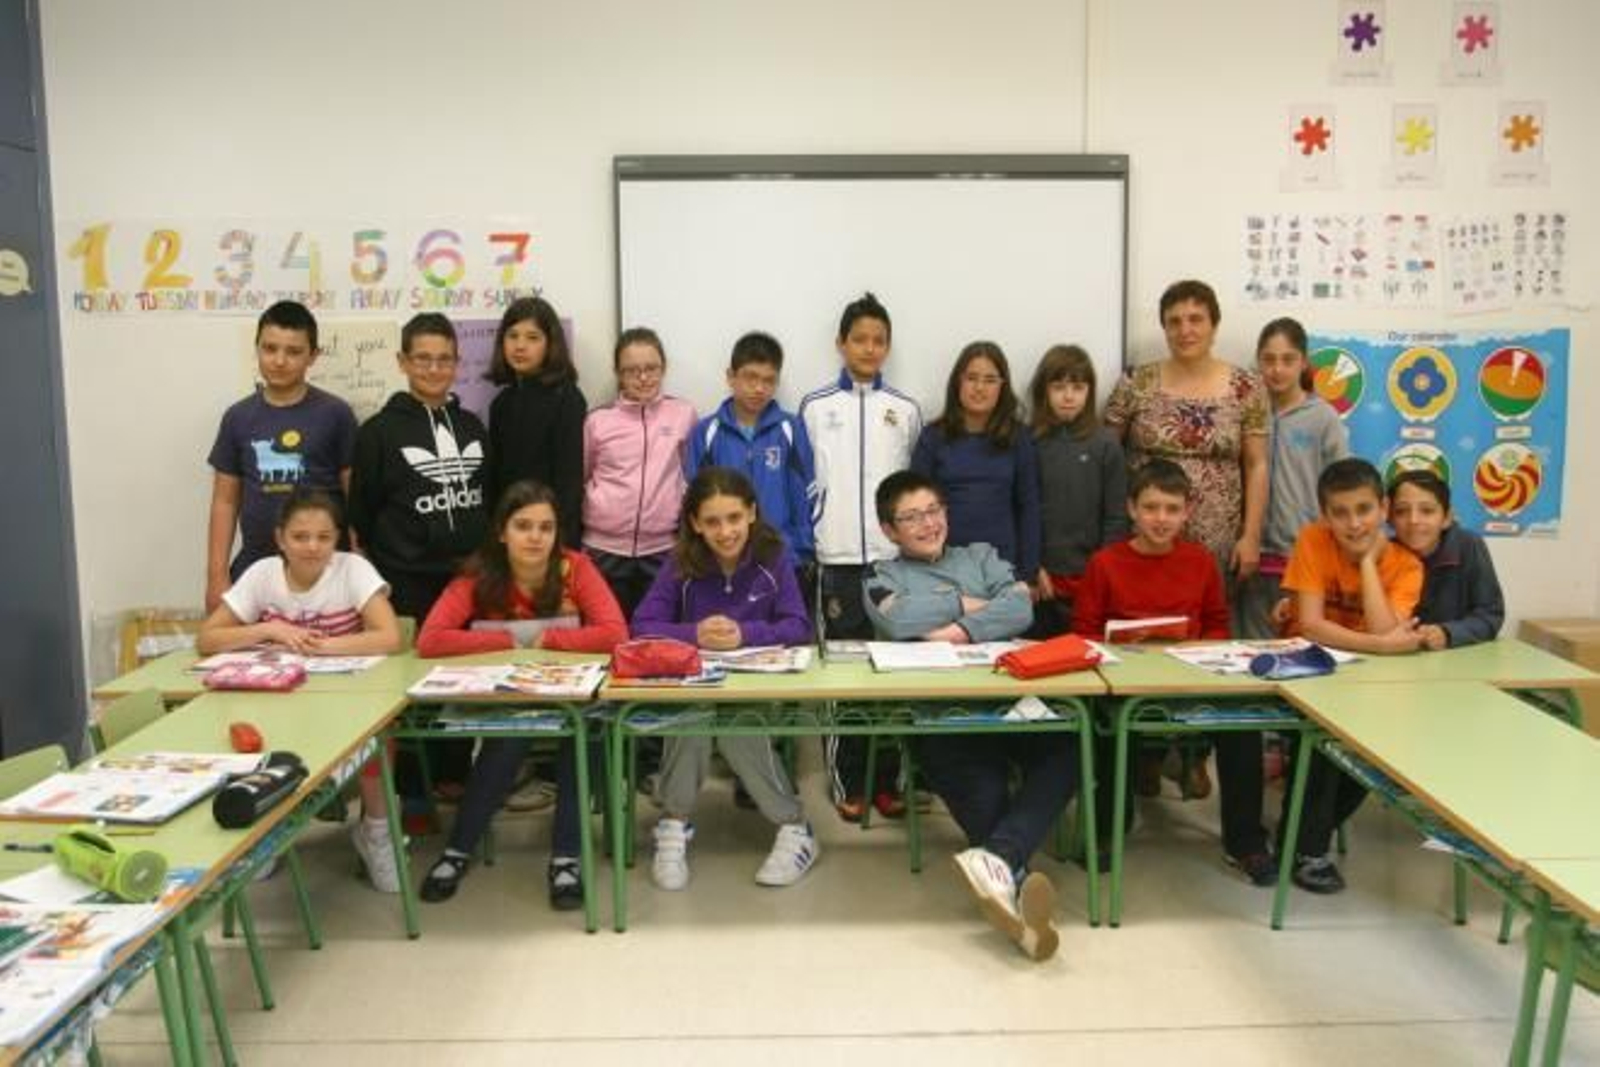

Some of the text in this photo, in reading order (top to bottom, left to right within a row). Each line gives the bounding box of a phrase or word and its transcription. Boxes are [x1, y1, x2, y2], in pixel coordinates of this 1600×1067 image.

[67, 221, 530, 295] 1 2 3 4 5 6 7
[415, 483, 482, 514] adida
